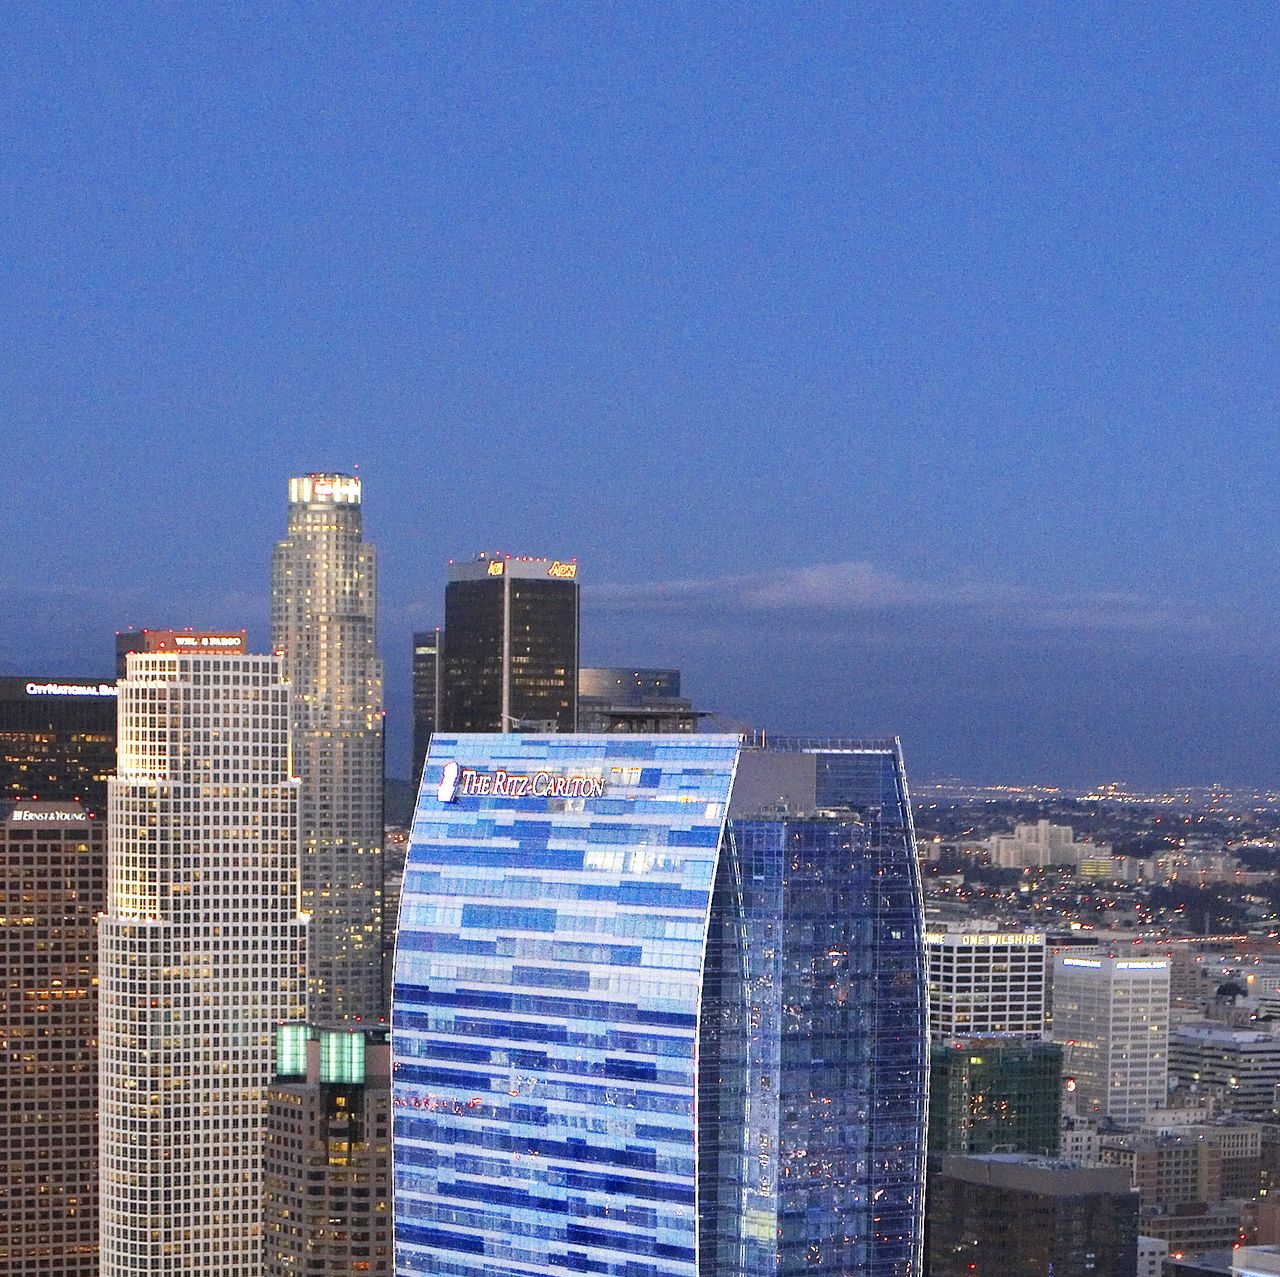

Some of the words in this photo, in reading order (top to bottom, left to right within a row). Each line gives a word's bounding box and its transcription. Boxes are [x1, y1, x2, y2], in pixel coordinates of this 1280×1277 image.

[462, 769, 491, 796] THE
[491, 769, 606, 798] RITZ-CARLTON
[962, 934, 985, 945] ONE
[988, 933, 1041, 945] WILSHIRE
